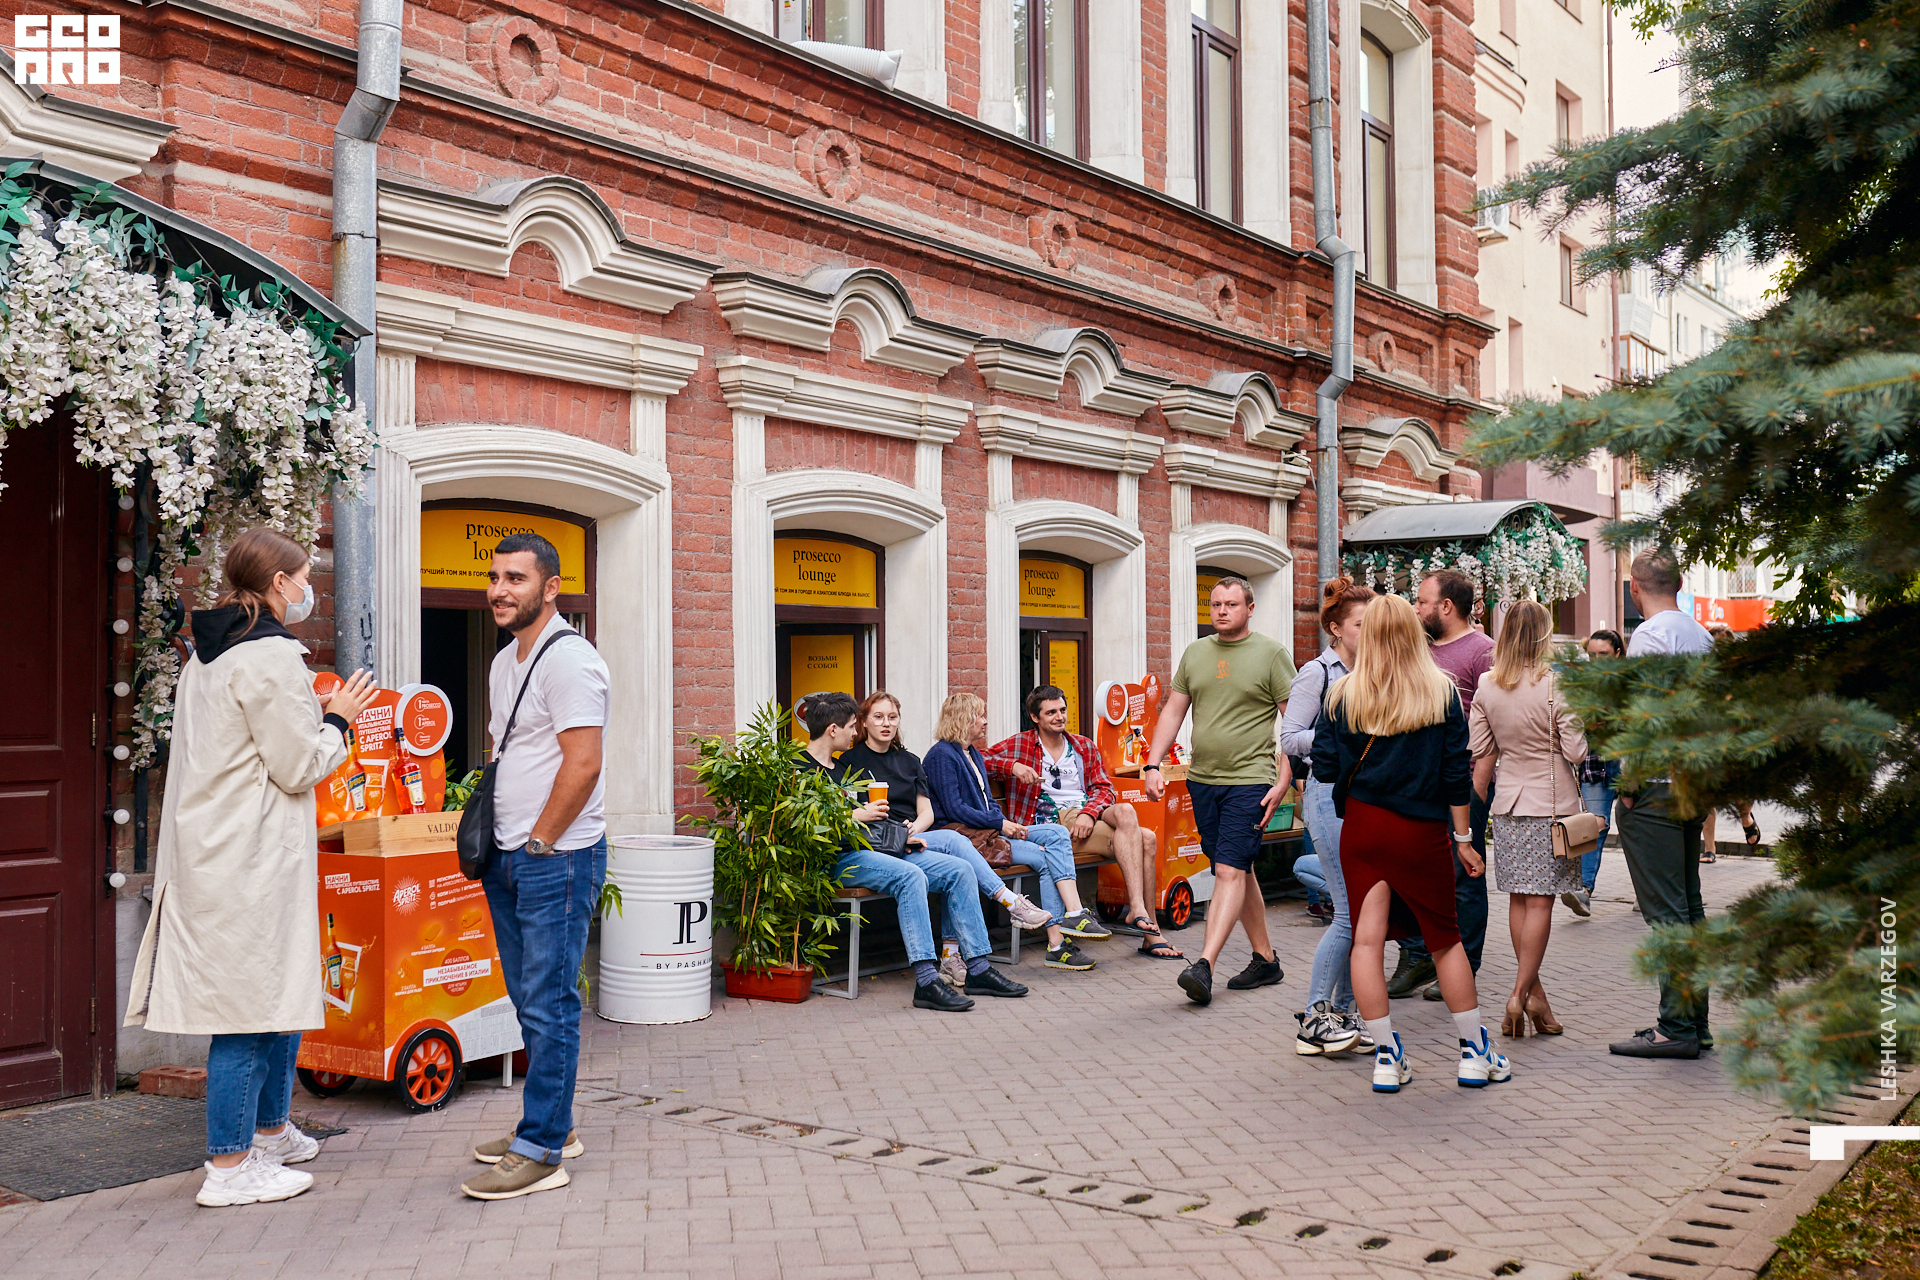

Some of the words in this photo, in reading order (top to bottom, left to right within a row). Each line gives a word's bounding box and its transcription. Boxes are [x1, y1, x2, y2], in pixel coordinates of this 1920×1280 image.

[793, 550, 842, 563] prosecco
[798, 564, 836, 585] lounge
[1024, 569, 1060, 580] prosecco
[1028, 581, 1056, 599] lounge
[357, 708, 390, 722] НАЧНИ
[366, 731, 392, 743] APEROL
[360, 741, 384, 753] SPRITZ
[342, 886, 362, 894] APEROL
[362, 884, 380, 892] SPRITZ
[393, 884, 420, 903] APEROL
[398, 894, 416, 907] SPRITZ
[438, 963, 477, 974] НЕЗАБЫВАЕМОЕ
[426, 972, 464, 984] ПРИКЛЮЧЕНИЕ
[469, 968, 489, 976] ИТАЛИИ
